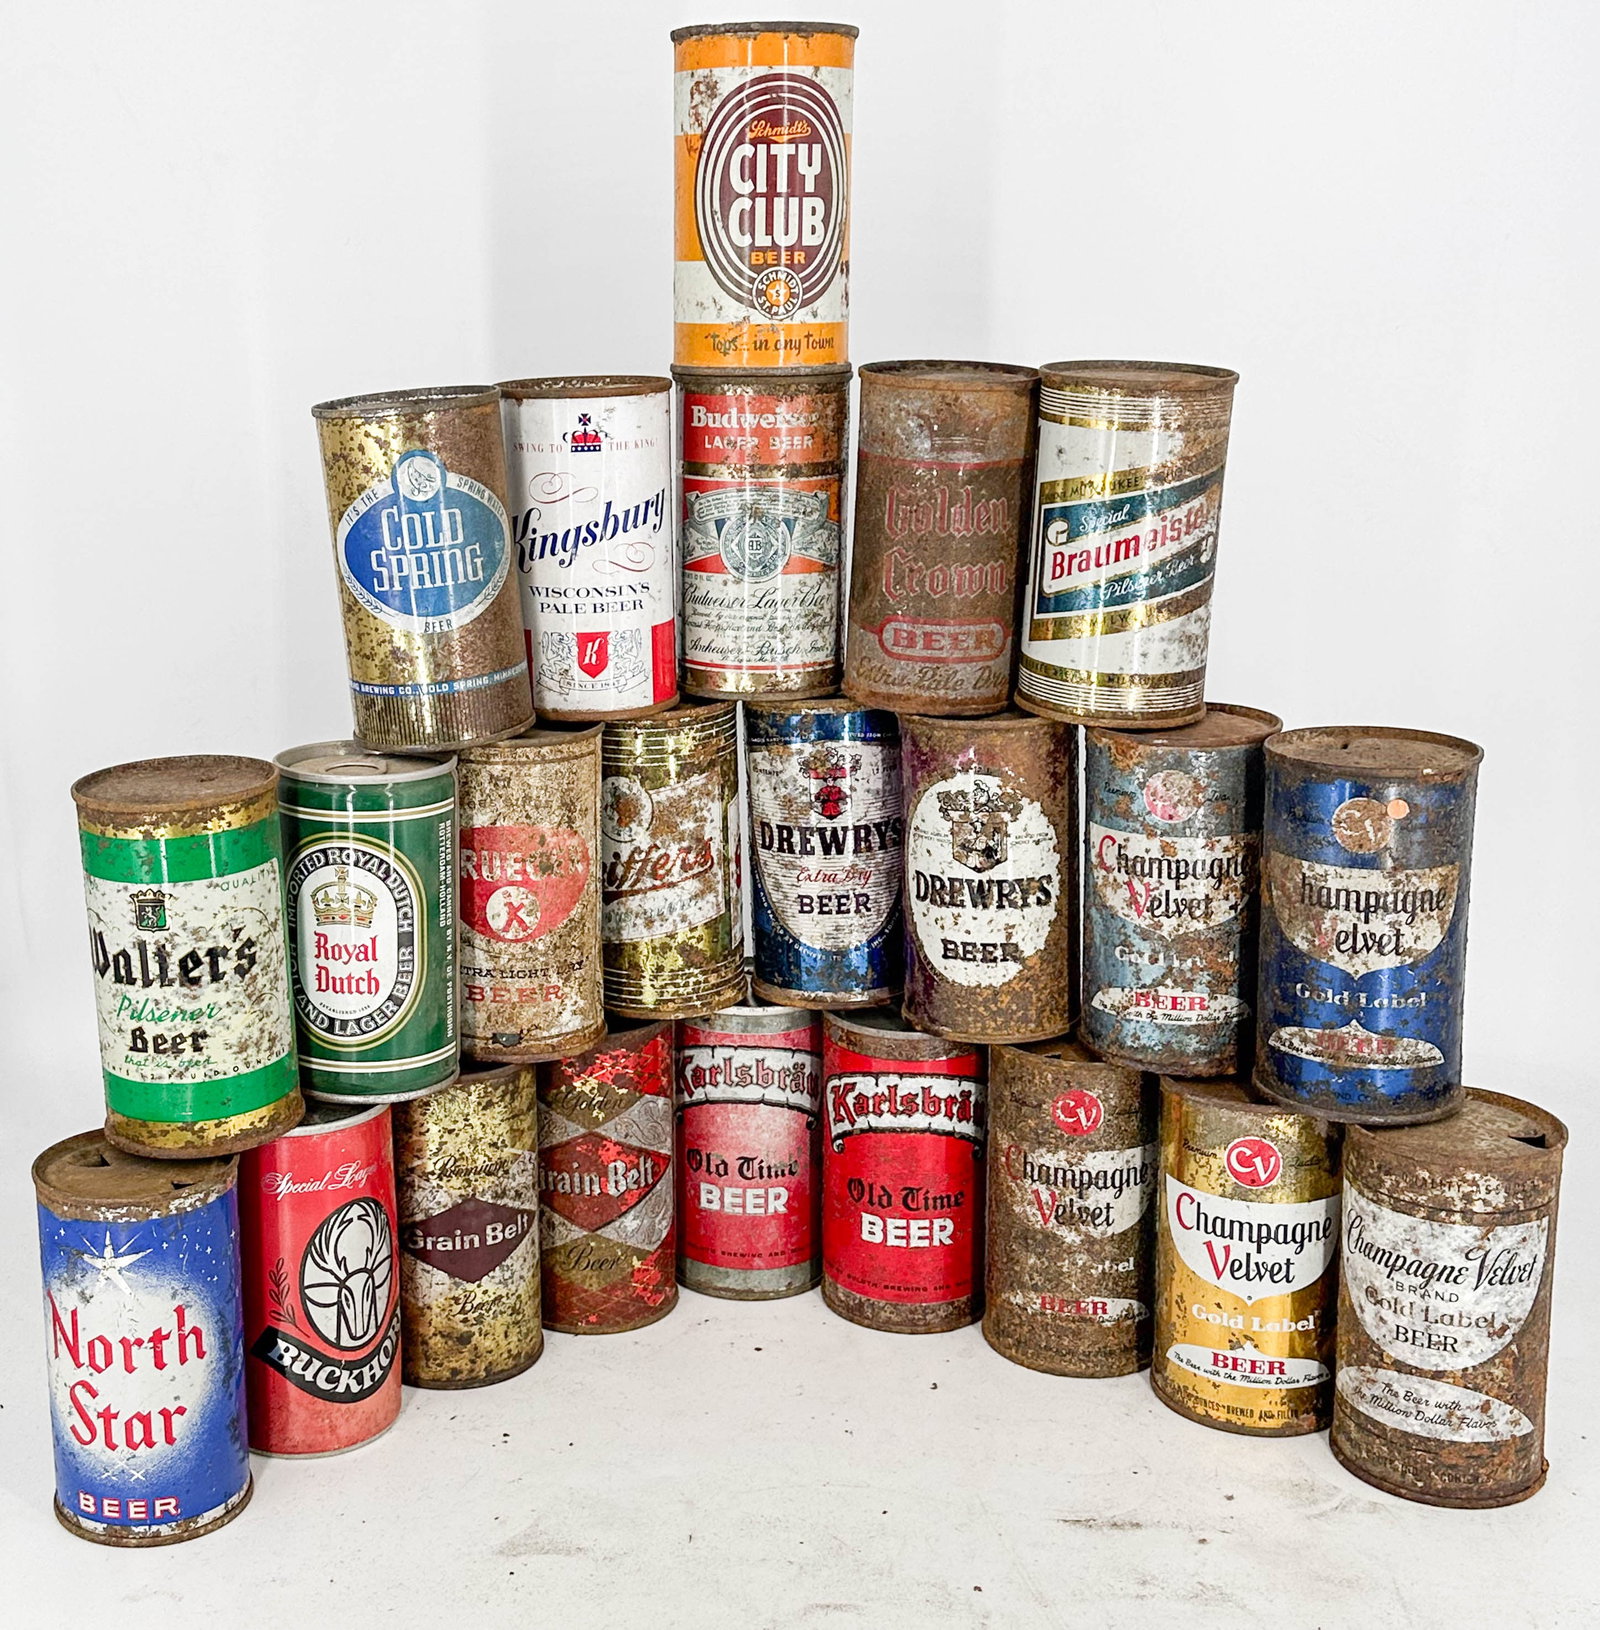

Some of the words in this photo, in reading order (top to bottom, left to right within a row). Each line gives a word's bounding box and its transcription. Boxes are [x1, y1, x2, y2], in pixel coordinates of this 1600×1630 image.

[748, 120, 812, 141] Schmidt's
[729, 143, 822, 194] CITY
[729, 197, 826, 248] CLUB
[750, 251, 806, 265] BEER
[757, 271, 799, 294] SCHMIDT
[771, 297, 798, 316] PAUL
[754, 334, 769, 351] in
[550, 443, 563, 454] TO
[608, 440, 630, 451] THE
[769, 435, 813, 450] BEER
[456, 476, 486, 500] SPRING
[344, 505, 361, 527] IT'S
[361, 488, 380, 508] THE
[1079, 503, 1130, 533] Special
[381, 505, 465, 551] COLD
[512, 487, 666, 574] Kingsbury
[1051, 502, 1208, 581] Braumeiste
[370, 542, 484, 593] SPRING
[882, 546, 1009, 601] Crown
[528, 582, 650, 599] WISCONSIN'S
[539, 602, 587, 615] PALE
[593, 599, 644, 614] BEER
[424, 618, 454, 634] BEER
[892, 628, 995, 651] BEER
[286, 850, 325, 927] IMPORTED
[327, 848, 388, 881] ROYAL
[387, 870, 414, 932] DUTCH
[796, 867, 838, 885] Extra
[840, 865, 874, 889] Dry
[915, 869, 1053, 910] DREWRYS
[797, 894, 872, 916] BEER
[1125, 878, 1215, 919] Velvet
[1300, 872, 1447, 925] hampagne
[502, 901, 530, 933] X
[89, 924, 258, 989] Walter's
[313, 930, 379, 966] Royal
[940, 939, 1024, 964] BEER
[315, 963, 380, 998] Dutch
[499, 967, 550, 980] LIGHT
[333, 999, 399, 1036] LAGER
[392, 945, 414, 996] BEER
[464, 984, 566, 1004] BEER
[1133, 990, 1209, 1012] BEER
[1357, 990, 1428, 1010] Label
[116, 994, 223, 1023] Pilsener
[128, 1026, 209, 1055] Beer
[675, 1054, 821, 1099] Karlsbräu
[1055, 1099, 1097, 1130] CV
[686, 1148, 730, 1179] Old
[1182, 1138, 1218, 1159] Premium
[1229, 1146, 1276, 1182] CV
[428, 1154, 510, 1181] Premium
[606, 1155, 656, 1198] Belt
[1005, 1143, 1149, 1199] Champagne
[261, 1170, 332, 1201] Special
[699, 1181, 790, 1217] BEER
[846, 1177, 893, 1209] Old
[900, 1185, 966, 1212] Time
[1031, 1187, 1116, 1228] Velvet
[1175, 1192, 1332, 1255] Champagne
[406, 1227, 481, 1252] Grain
[485, 1212, 529, 1246] Belt
[860, 1211, 955, 1248] BEER
[565, 1243, 624, 1272] Beer
[1203, 1240, 1296, 1284] Velvet
[1346, 1207, 1469, 1290] Champagne
[1464, 1246, 1538, 1292] Velvet
[453, 1290, 501, 1317] Beer
[1364, 1285, 1414, 1318] Gold
[1395, 1281, 1460, 1304] BRAND
[46, 1288, 208, 1375] North
[1191, 1303, 1245, 1330] Gold
[1251, 1314, 1316, 1333] Label
[266, 1308, 401, 1394] BUCKHOR
[1393, 1323, 1460, 1354] BEER
[1203, 1366, 1222, 1378] with
[1223, 1371, 1238, 1382] the
[1239, 1374, 1273, 1386] Million
[1274, 1376, 1301, 1386] Dollar
[1211, 1351, 1287, 1376] BEER
[1368, 1393, 1413, 1419] Million
[1413, 1409, 1455, 1427] Dollar
[1379, 1380, 1400, 1399] The
[1402, 1389, 1430, 1407] Beer
[1433, 1398, 1463, 1412] with
[69, 1379, 188, 1451] Star
[77, 1489, 181, 1521] BEER
